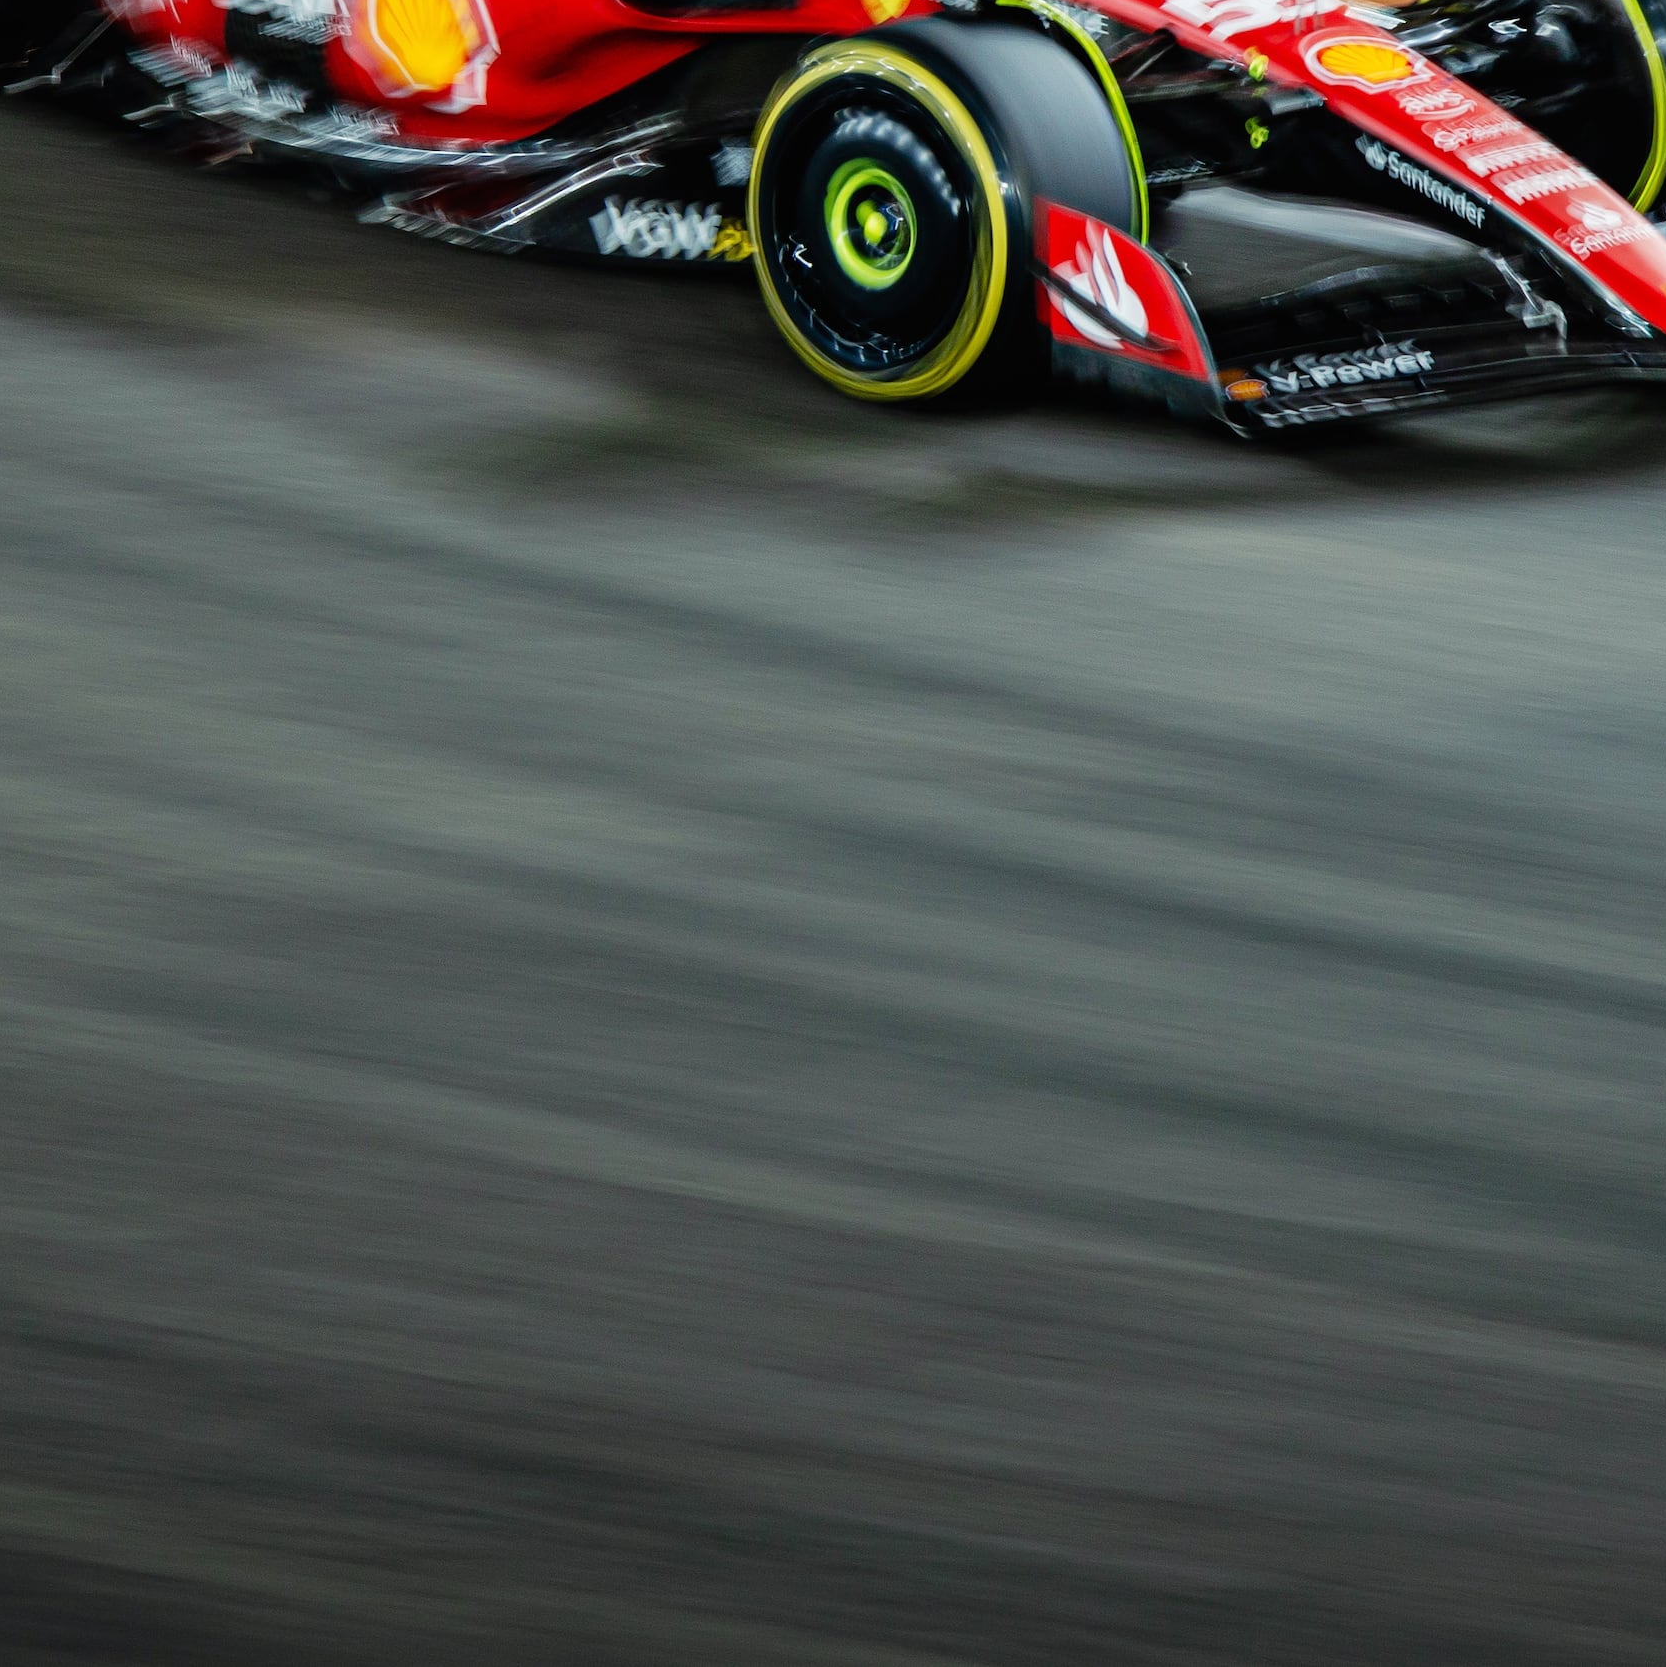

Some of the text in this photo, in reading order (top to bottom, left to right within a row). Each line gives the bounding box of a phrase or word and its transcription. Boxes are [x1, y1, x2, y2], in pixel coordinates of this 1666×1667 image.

[1399, 86, 1465, 116] aws
[1387, 149, 1486, 230] Santander
[1269, 349, 1435, 394] V-Power
